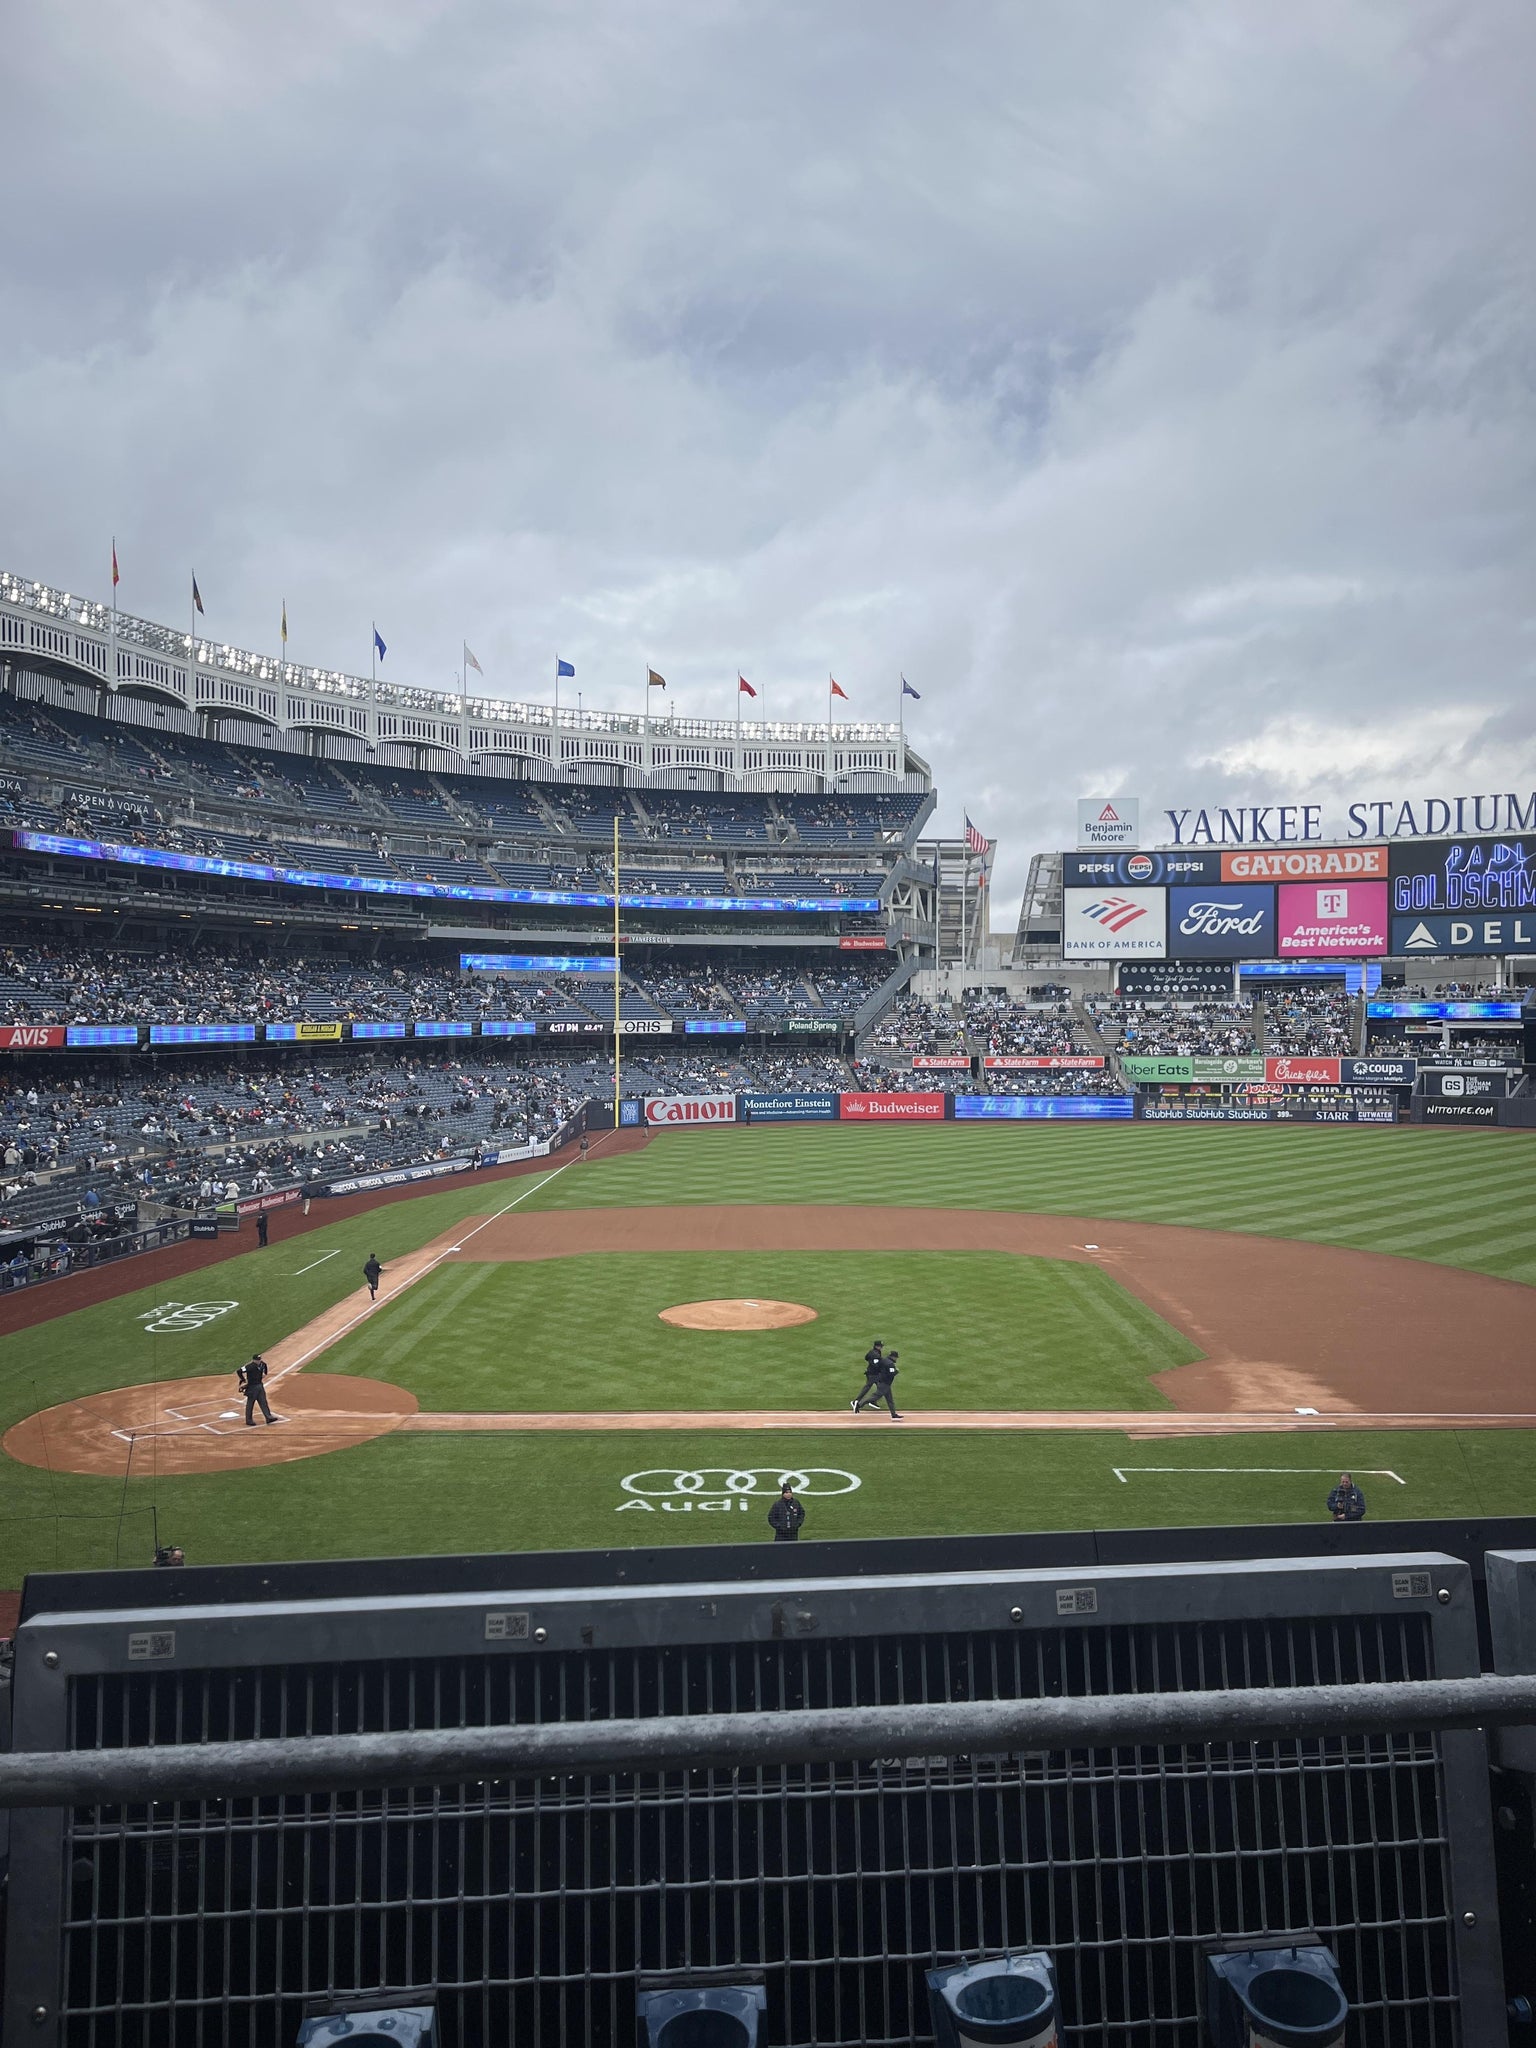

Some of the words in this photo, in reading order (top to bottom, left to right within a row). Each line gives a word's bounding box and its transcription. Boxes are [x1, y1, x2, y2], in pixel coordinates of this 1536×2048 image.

[70, 793, 104, 806] ASPEN
[1164, 806, 1322, 844] YANKEE
[1348, 792, 1536, 838] STADIUM
[1085, 823, 1132, 834] Benjamin
[1091, 833, 1125, 842] Moore
[1452, 843, 1525, 864] PAUL
[1078, 864, 1114, 873] PEPSI
[1167, 862, 1204, 872] PEPSI
[1231, 852, 1379, 876] GATORADE
[1180, 902, 1264, 934] Ford
[1282, 937, 1315, 947] Best
[1318, 936, 1384, 946] Network
[550, 1023, 565, 1032] 4:17
[566, 1023, 578, 1032] PM
[625, 1021, 660, 1032] ORIS
[789, 1021, 812, 1030] Poland
[814, 1021, 837, 1031] Spring
[9, 1029, 49, 1045] AVIS
[1125, 1064, 1155, 1075] Uber
[1158, 1064, 1189, 1075] Eats
[1275, 1061, 1330, 1081] Chick-fil-A
[1369, 1064, 1403, 1075] coupa
[1243, 1083, 1283, 1094] Jersey
[1445, 1081, 1460, 1090] GS
[745, 1099, 792, 1108] Montefiore
[795, 1099, 831, 1107] Einstein
[869, 1102, 939, 1114] Budweiser
[646, 1100, 733, 1122] Canon
[1146, 1110, 1183, 1119] StubHub
[1186, 1110, 1224, 1119] StubHub
[1228, 1110, 1267, 1119] StubHub
[1316, 1111, 1349, 1120] STARR
[1427, 1104, 1494, 1116] NITTOTIRE.COM
[41, 1220, 66, 1232] StubHub
[614, 1498, 748, 1511] Audi
